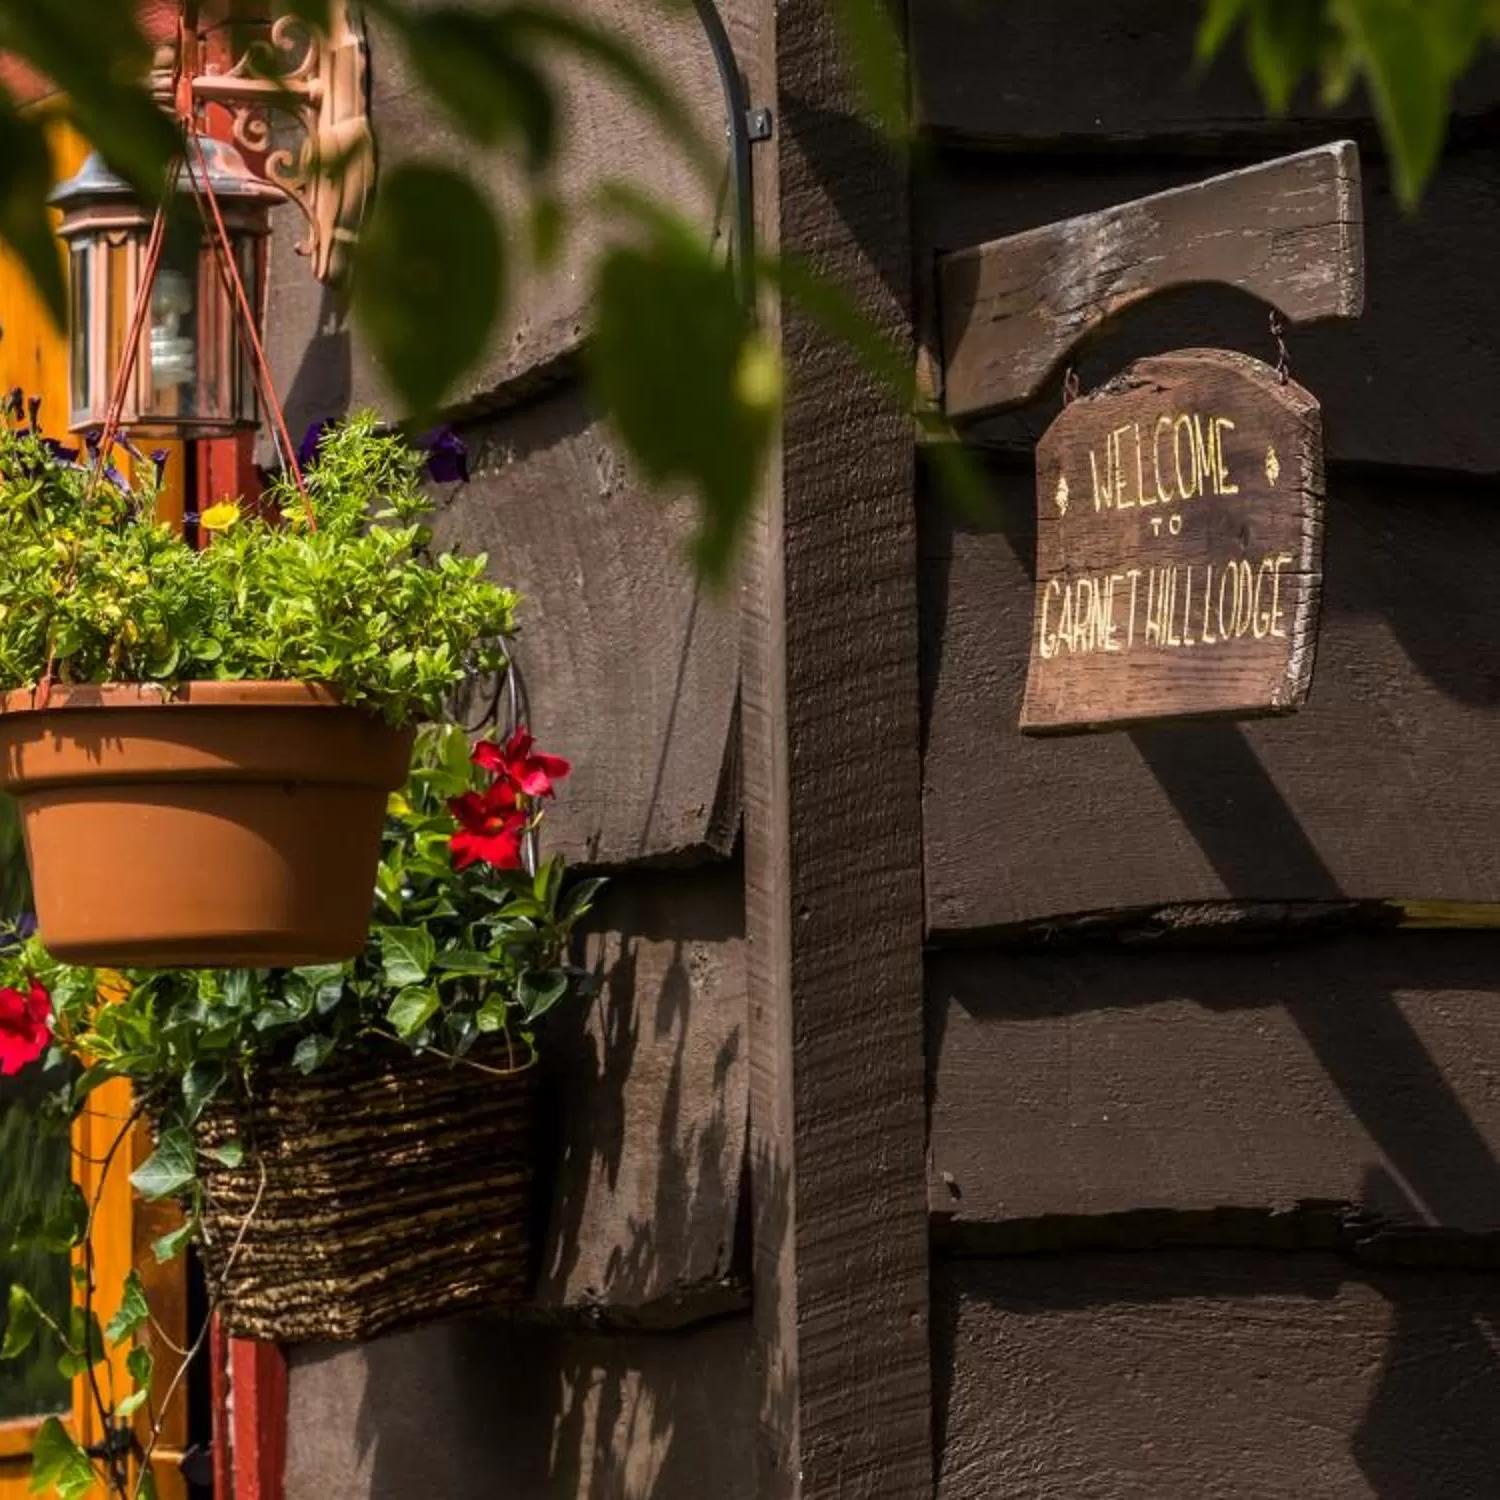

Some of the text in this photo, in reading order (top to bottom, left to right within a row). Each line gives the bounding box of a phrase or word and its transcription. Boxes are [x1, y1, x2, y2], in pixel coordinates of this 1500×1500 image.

[1089, 413, 1239, 512] WELCOME
[1150, 514, 1183, 536] TO
[1040, 554, 1293, 659] GARNET HILL LODGE
